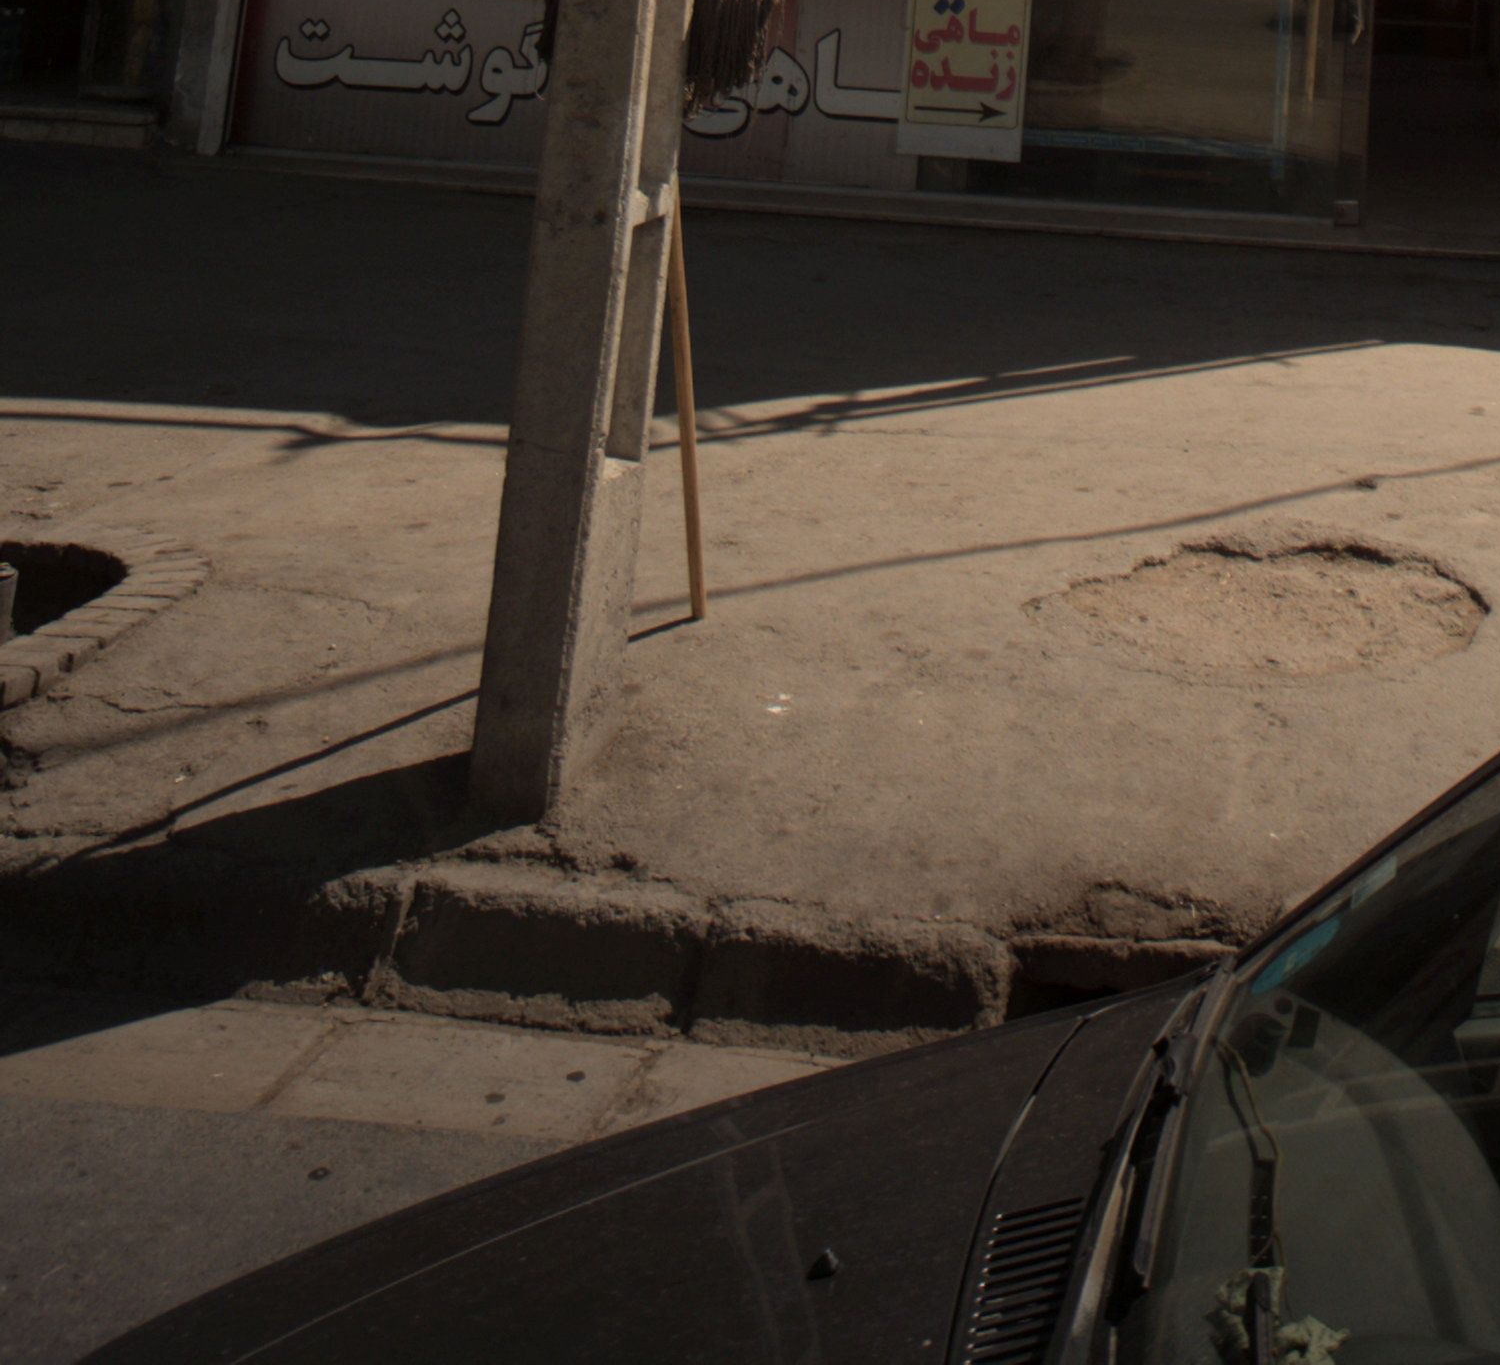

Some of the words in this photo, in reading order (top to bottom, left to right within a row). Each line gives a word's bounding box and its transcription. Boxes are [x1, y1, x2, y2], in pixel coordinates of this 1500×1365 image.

[273, 7, 551, 127] گوشت
[913, 7, 1021, 54] ماهی
[681, 28, 900, 139] اهی
[911, 47, 1017, 102] زنده
